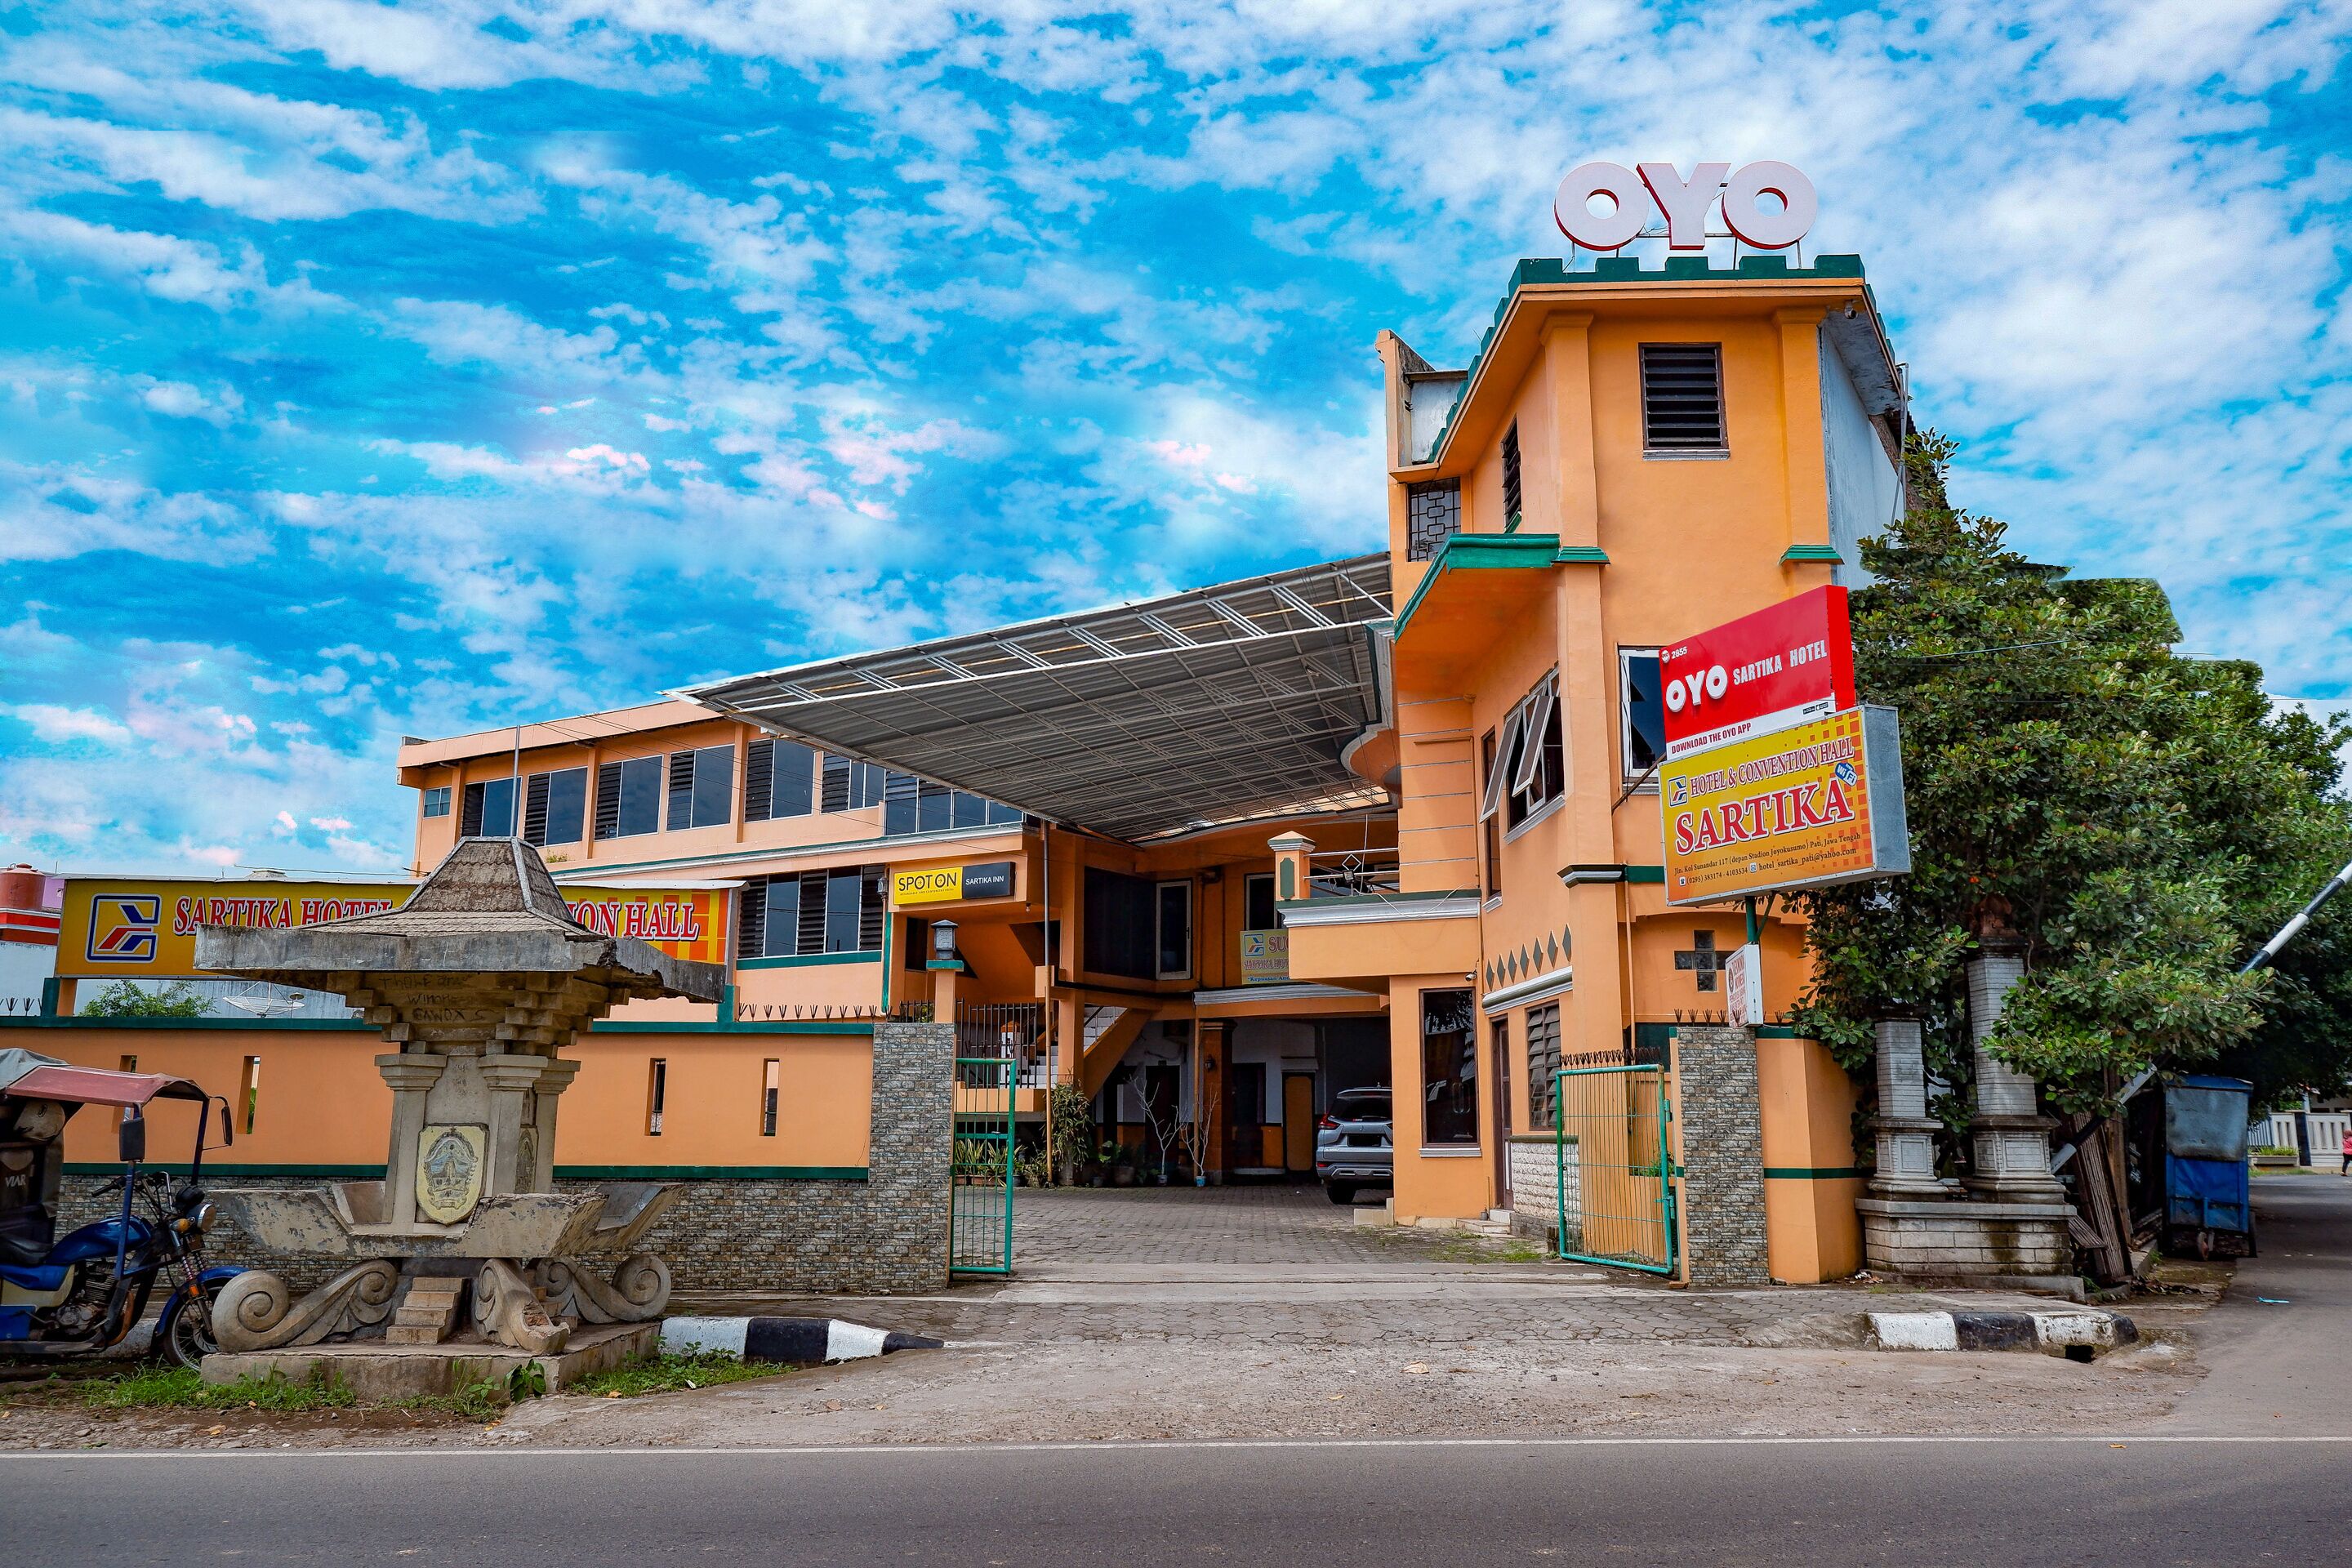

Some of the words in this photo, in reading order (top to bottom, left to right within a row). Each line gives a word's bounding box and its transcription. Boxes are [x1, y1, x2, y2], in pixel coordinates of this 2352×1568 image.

[1553, 161, 1818, 252] OYO
[1665, 665, 1728, 713] OYO
[1733, 654, 1783, 685] SARTIKA
[1789, 639, 1828, 668] HOTEL
[1671, 736, 1708, 754] DOWNLOAD
[1708, 732, 1722, 742] THE
[1722, 727, 1736, 739] OYO
[1737, 722, 1752, 734] APP
[1690, 770, 1726, 797] HOTEL
[1728, 766, 1737, 787] &
[1738, 745, 1819, 785] CONVENTION
[1820, 737, 1855, 764] HALL
[1675, 778, 1855, 855] SARTIKA
[1673, 867, 1684, 875] Jln.
[1694, 860, 1717, 870] Sunandar
[1719, 858, 1728, 866] 117
[1729, 854, 1748, 865] (depan
[1748, 850, 1770, 860] Stadion
[1770, 839, 1808, 858] Joyokusumo)
[1824, 838, 1838, 847] Jawa
[1838, 832, 1861, 842] Tengah
[1758, 847, 1857, 871] hotel_sartika_pati@yahoo.com
[898, 874, 933, 892] SPOT
[935, 872, 957, 888] ON
[965, 876, 991, 886] SARTIKA
[1686, 875, 1704, 884] (0295)
[1704, 871, 1722, 881] 383174
[173, 895, 294, 936] SARTIKA
[623, 902, 700, 942] HALL
[1268, 935, 1289, 954] SU
[5, 1174, 27, 1187] VIAR
